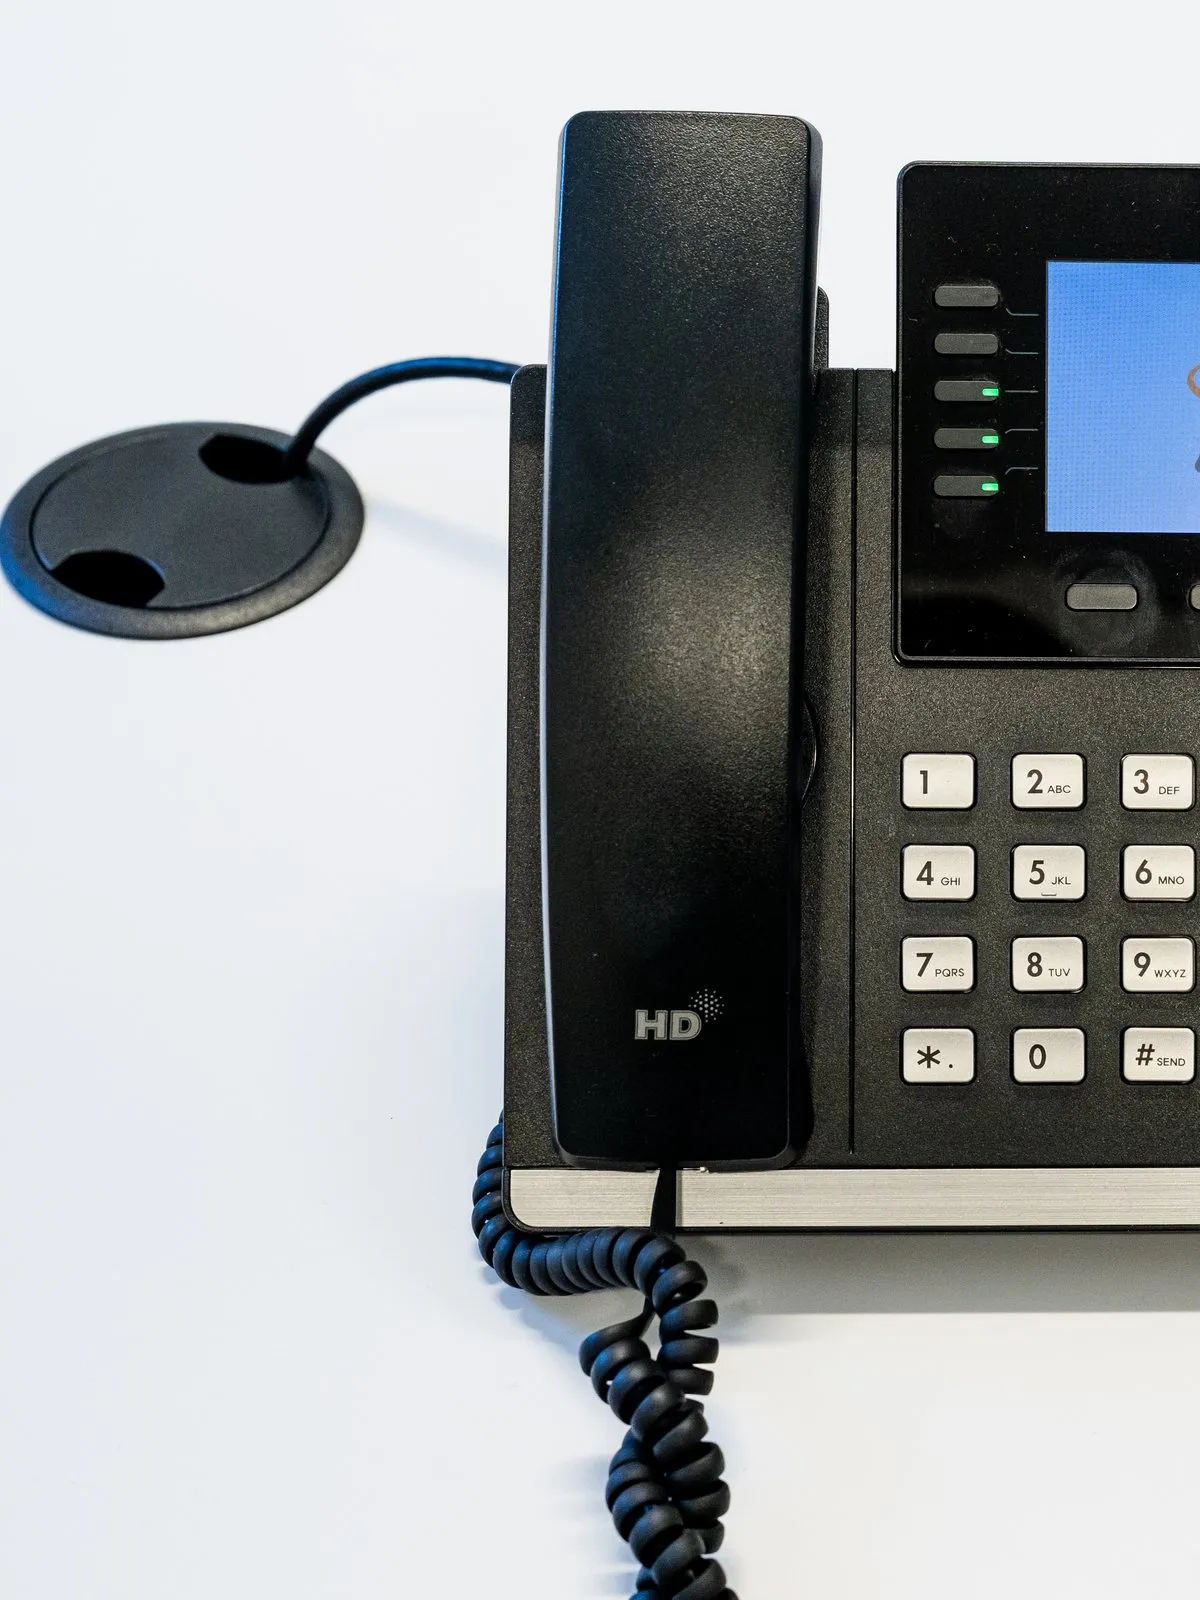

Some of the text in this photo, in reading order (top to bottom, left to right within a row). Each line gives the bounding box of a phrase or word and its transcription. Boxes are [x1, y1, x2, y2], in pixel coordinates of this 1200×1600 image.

[919, 769, 929, 795] 1
[1027, 768, 1071, 794] 2 ABC
[1133, 769, 1180, 795] 3 DEF
[916, 860, 961, 886] 4 GHI
[1029, 859, 1072, 886] 5 JKL
[1135, 859, 1185, 885] 6 MNO
[916, 952, 965, 978] 7 PQRS
[1026, 951, 1071, 978] 8 TUV
[1133, 951, 1186, 978] 9 WXYZ
[634, 1009, 702, 1041] HD
[1028, 1043, 1047, 1070] 0
[1156, 1057, 1186, 1067] SEND
